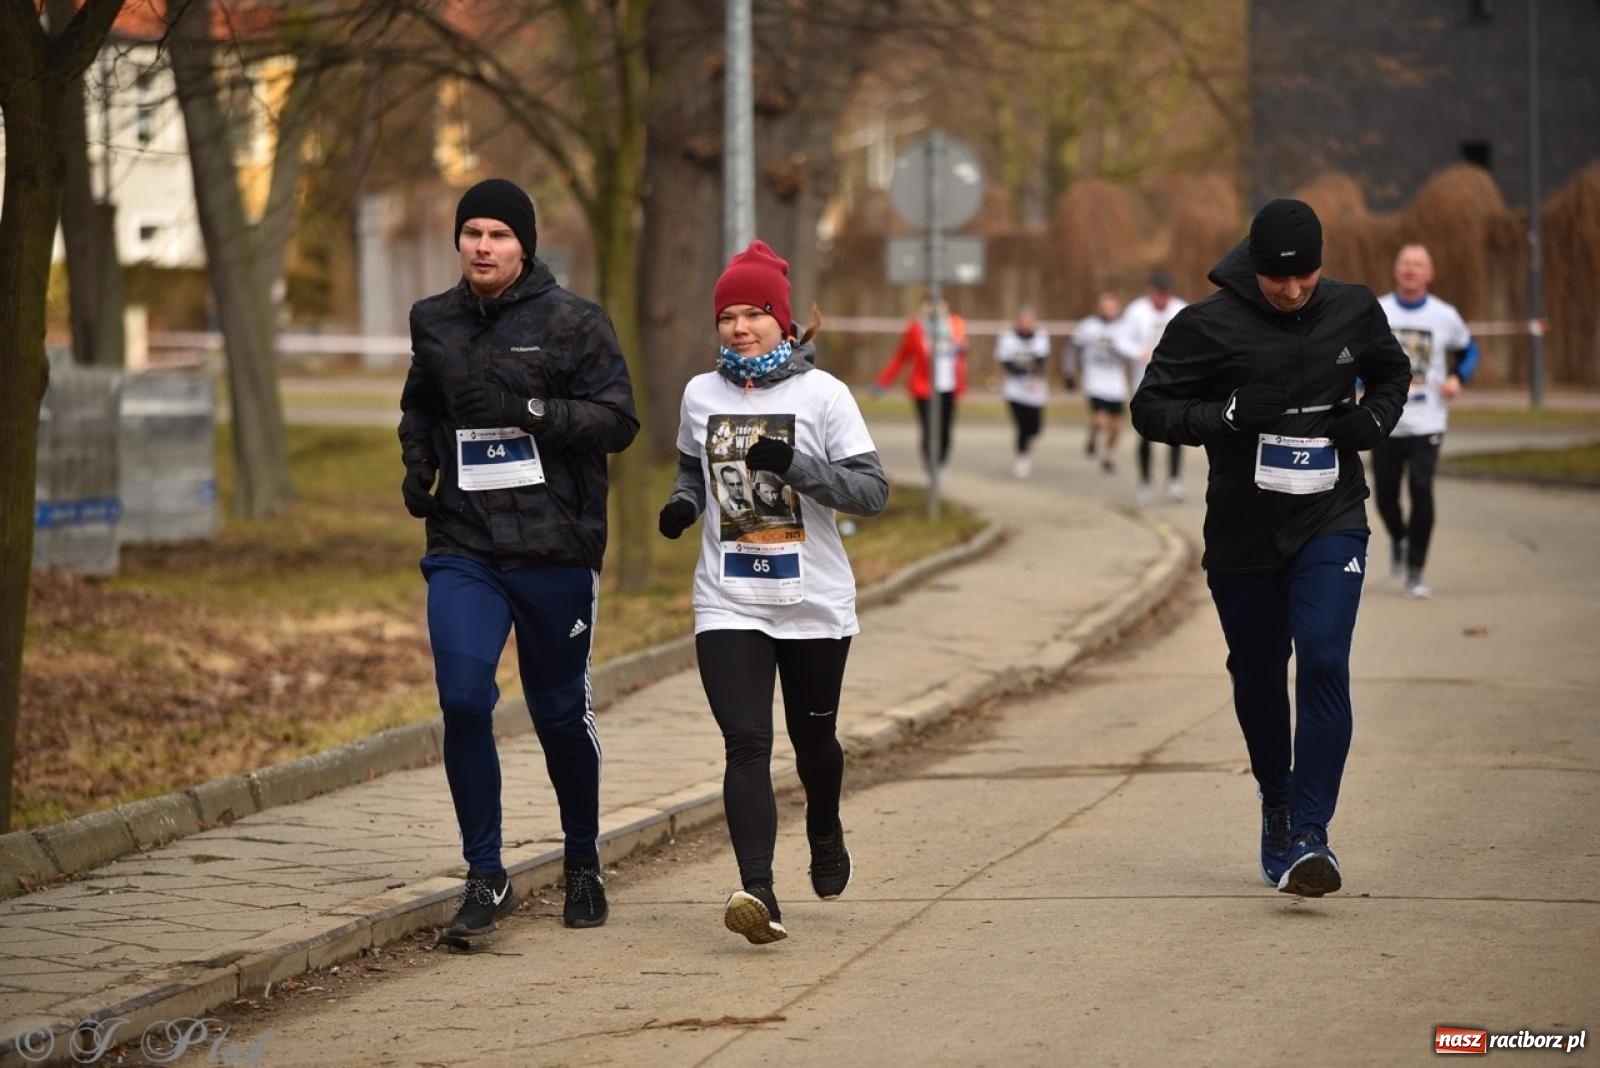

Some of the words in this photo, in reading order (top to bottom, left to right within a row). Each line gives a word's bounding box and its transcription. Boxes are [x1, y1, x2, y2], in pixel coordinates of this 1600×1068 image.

[486, 444, 506, 459] 64
[1291, 451, 1311, 465] 72
[753, 558, 771, 573] 65
